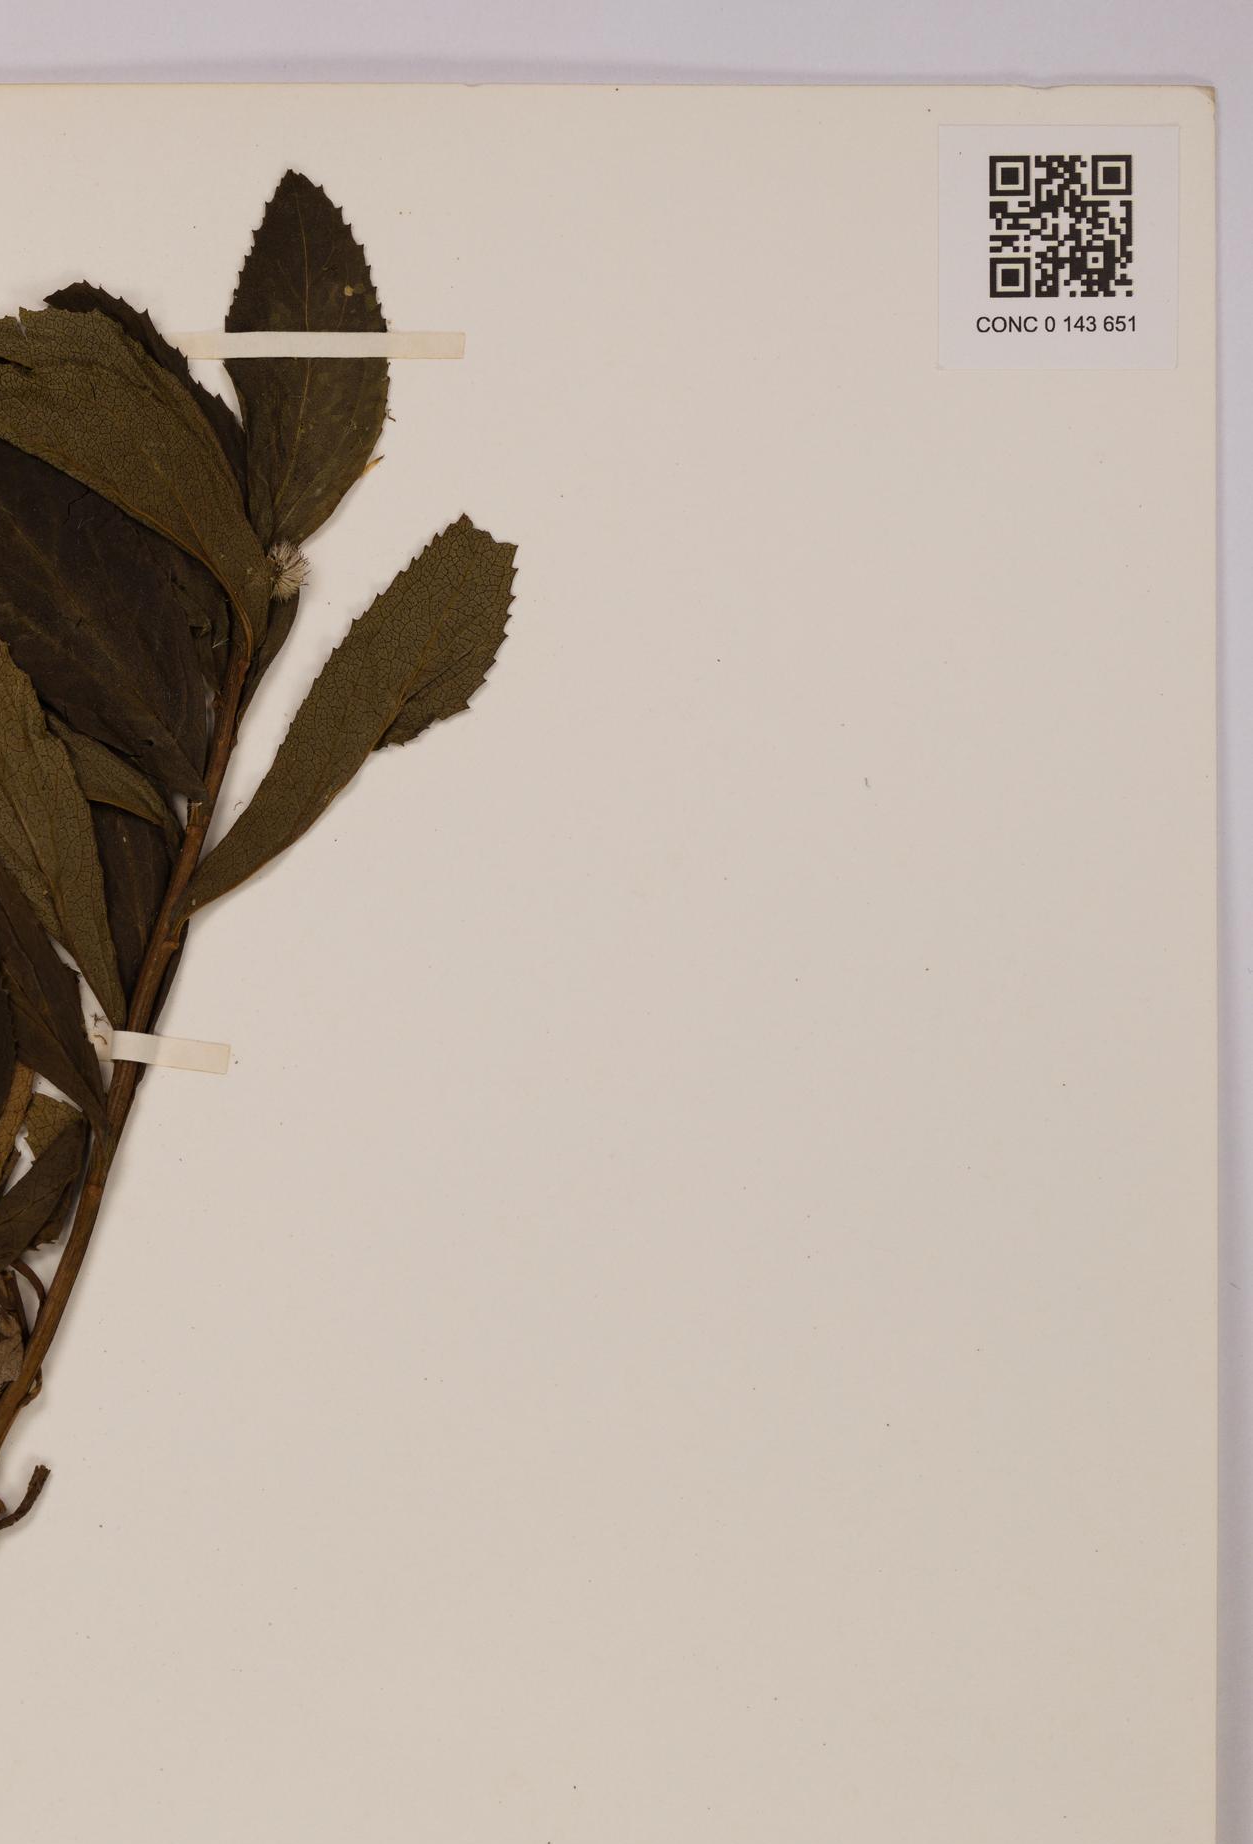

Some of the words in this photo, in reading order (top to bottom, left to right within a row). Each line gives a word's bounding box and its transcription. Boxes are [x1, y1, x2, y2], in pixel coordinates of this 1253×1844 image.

[976, 315, 1038, 333] CONC
[1044, 315, 1056, 333] 0
[1063, 315, 1097, 333] 143
[1103, 315, 1136, 333] 651
